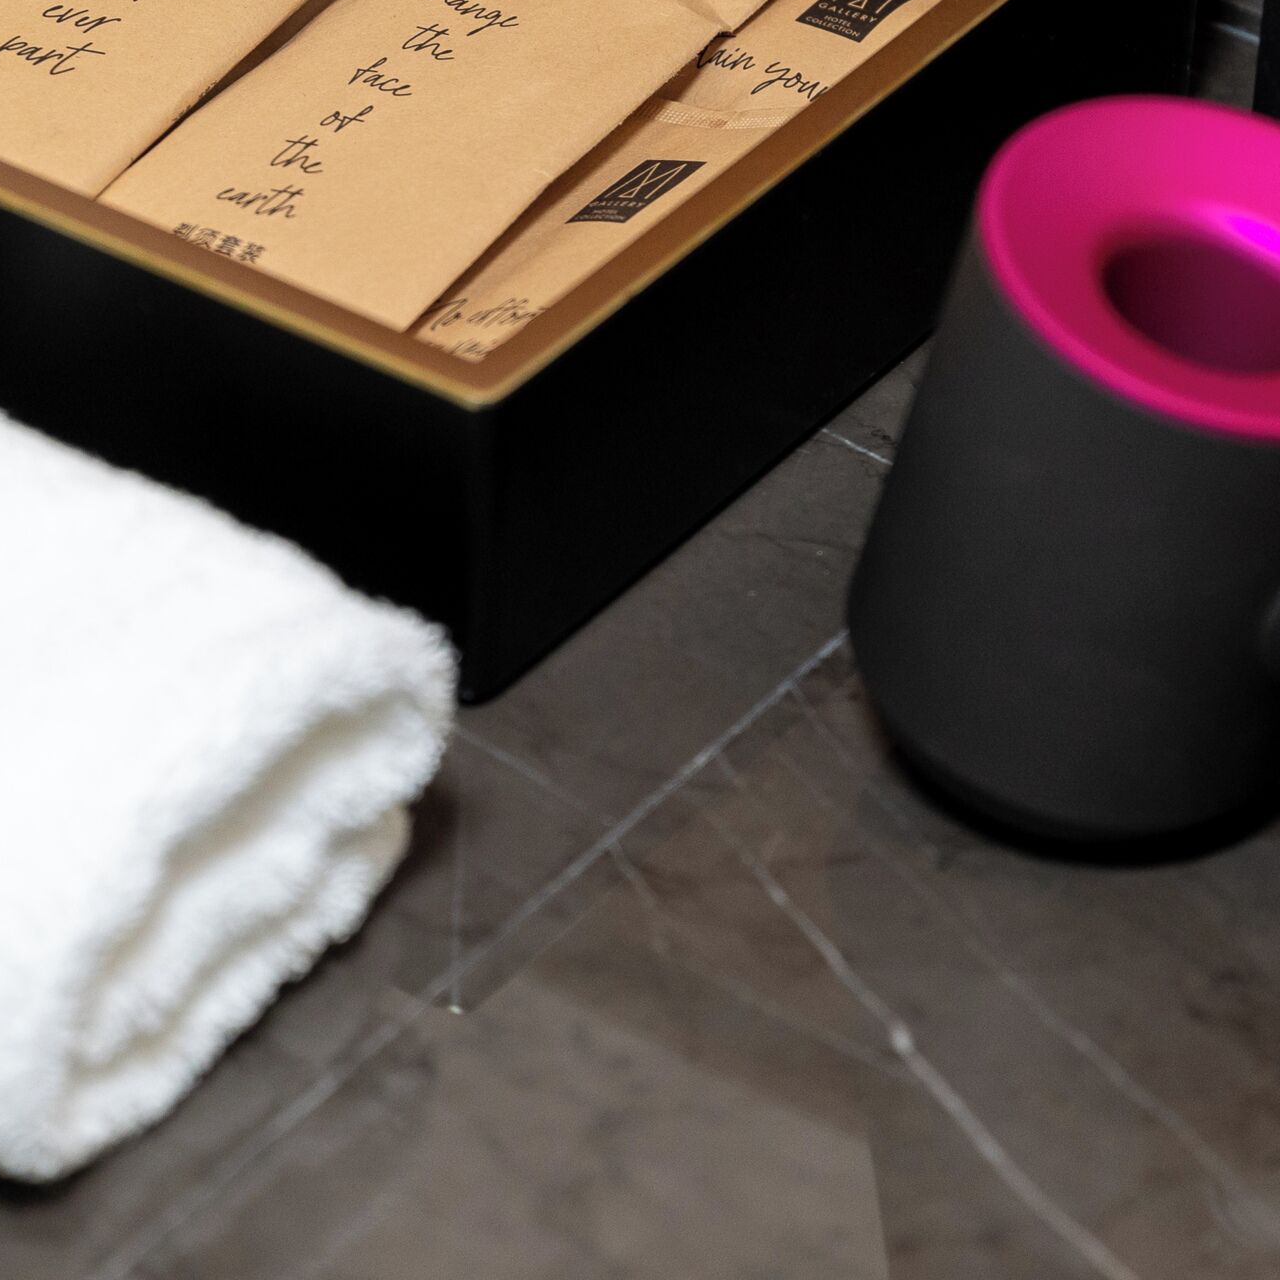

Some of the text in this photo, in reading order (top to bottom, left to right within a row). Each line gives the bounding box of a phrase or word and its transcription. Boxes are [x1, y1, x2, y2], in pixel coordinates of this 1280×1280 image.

[42, 4, 122, 34] ever
[818, 0, 878, 23] GALLERY
[823, 14, 853, 28] HOTEL
[805, 15, 862, 38] COLLECTION
[402, 23, 455, 61] the
[348, 57, 413, 97] face
[320, 105, 374, 133] of
[270, 135, 324, 174] the
[216, 184, 305, 219] earth
[588, 200, 647, 208] GALLERY
